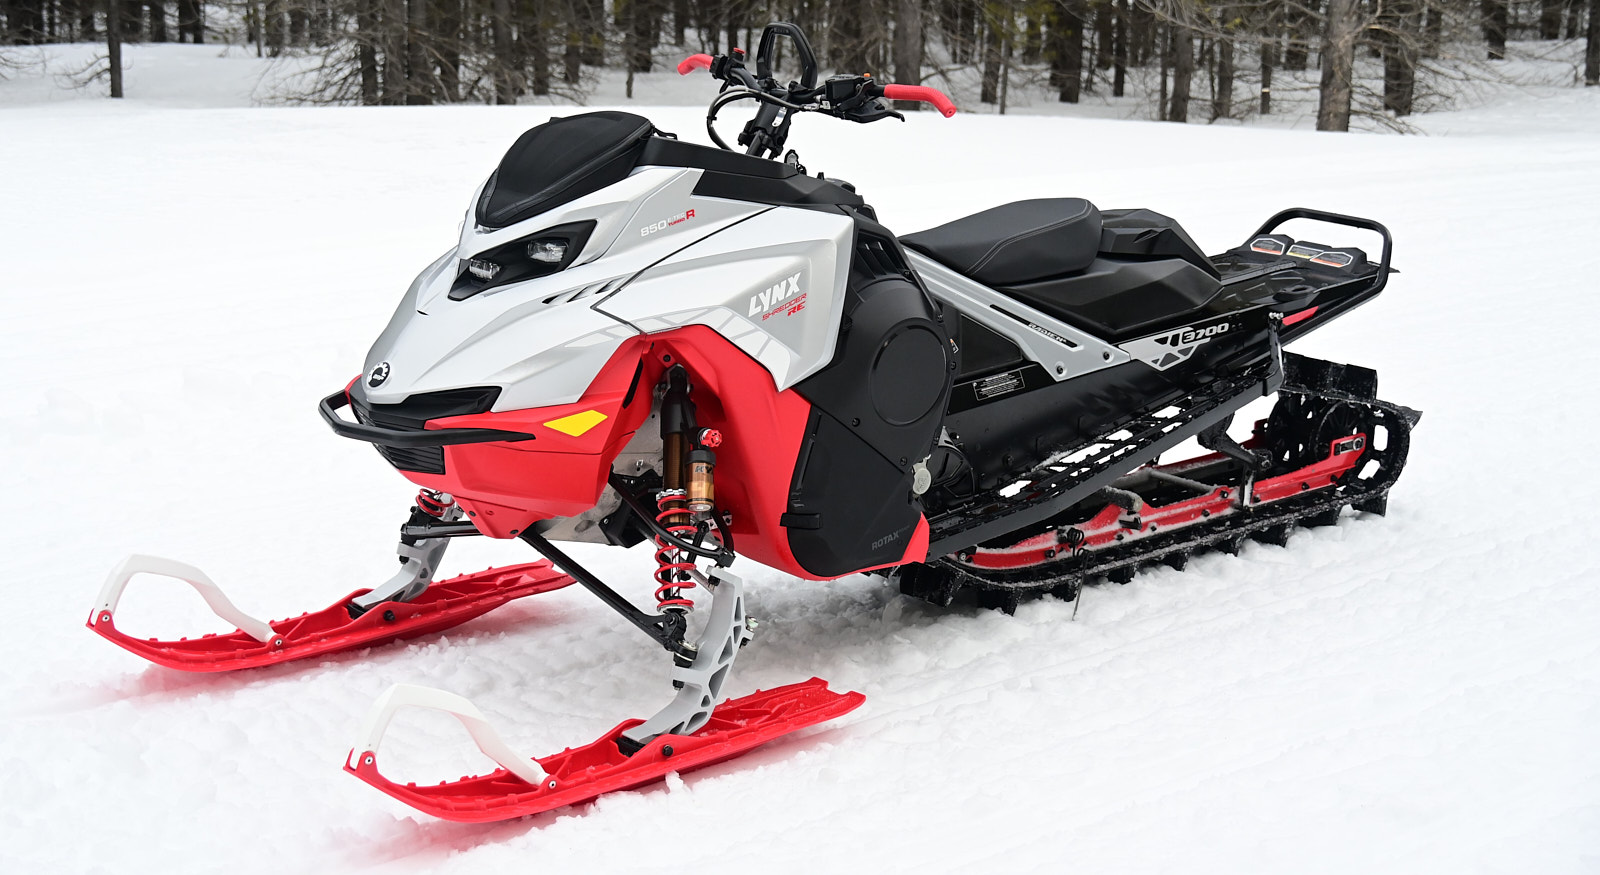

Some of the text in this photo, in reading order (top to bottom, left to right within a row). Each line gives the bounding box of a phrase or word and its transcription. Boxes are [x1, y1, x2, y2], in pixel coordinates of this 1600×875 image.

[686, 208, 696, 220] R
[640, 220, 667, 237] 850
[748, 272, 801, 318] LYNX
[762, 293, 807, 321] SHREDDER
[787, 301, 806, 317] RE
[1183, 322, 1230, 343] 3700
[871, 530, 900, 551] ROTAX
